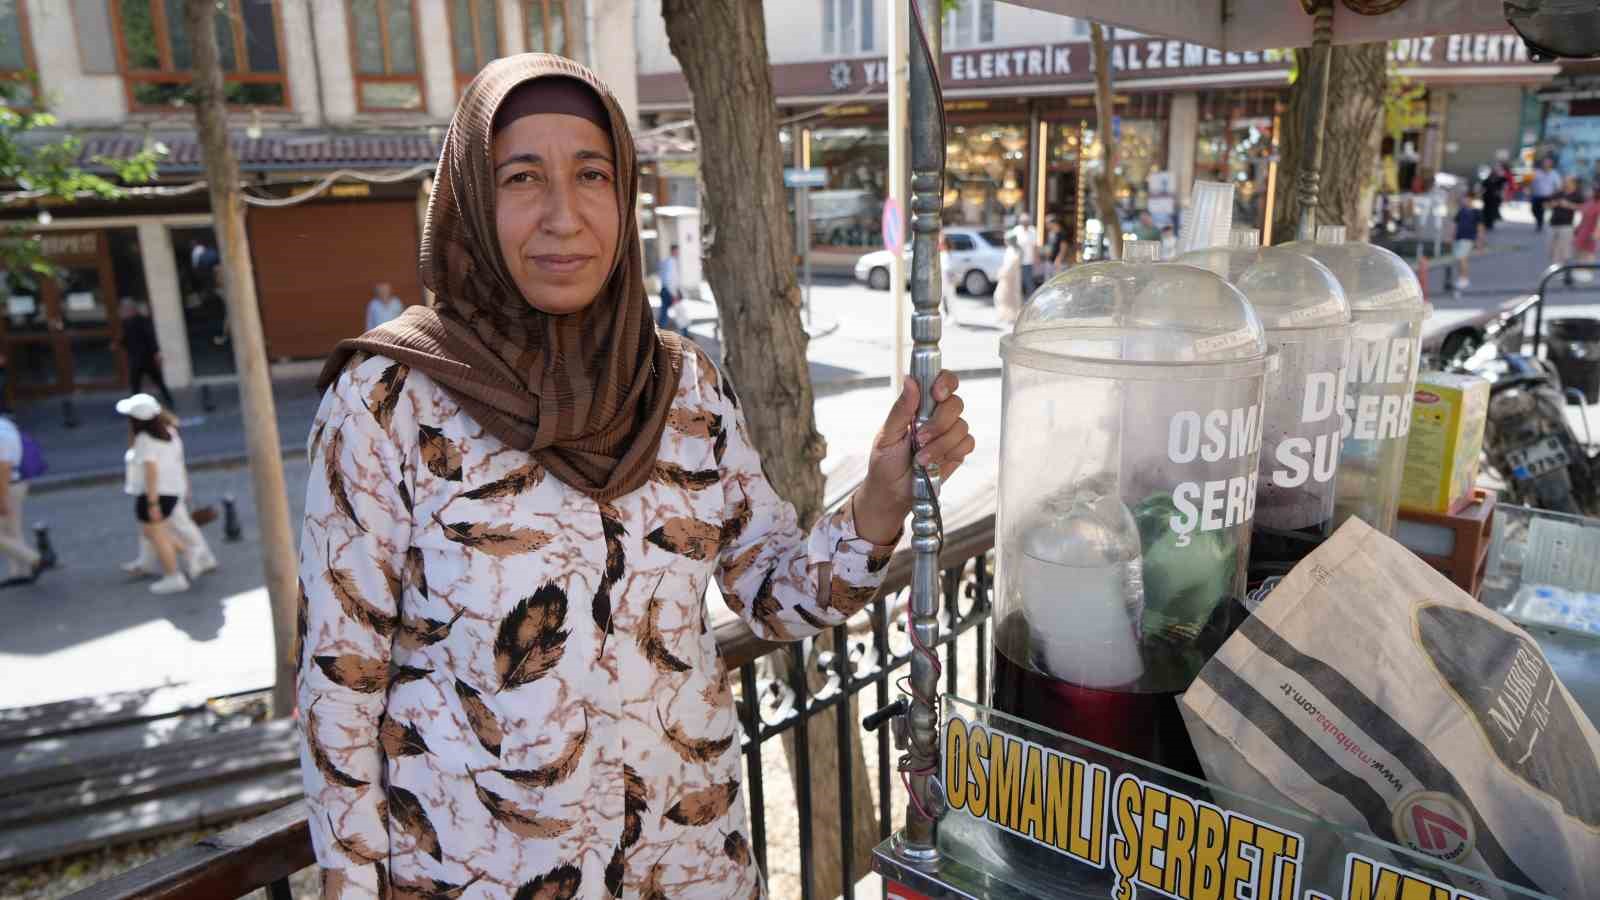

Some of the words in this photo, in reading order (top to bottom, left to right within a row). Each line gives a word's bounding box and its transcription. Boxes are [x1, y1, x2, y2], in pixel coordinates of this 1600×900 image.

[951, 45, 1071, 80] ELEKTRİK
[945, 716, 1108, 866] OSMANLI
[1280, 682, 1404, 793] www.mahbuba.com.tr
